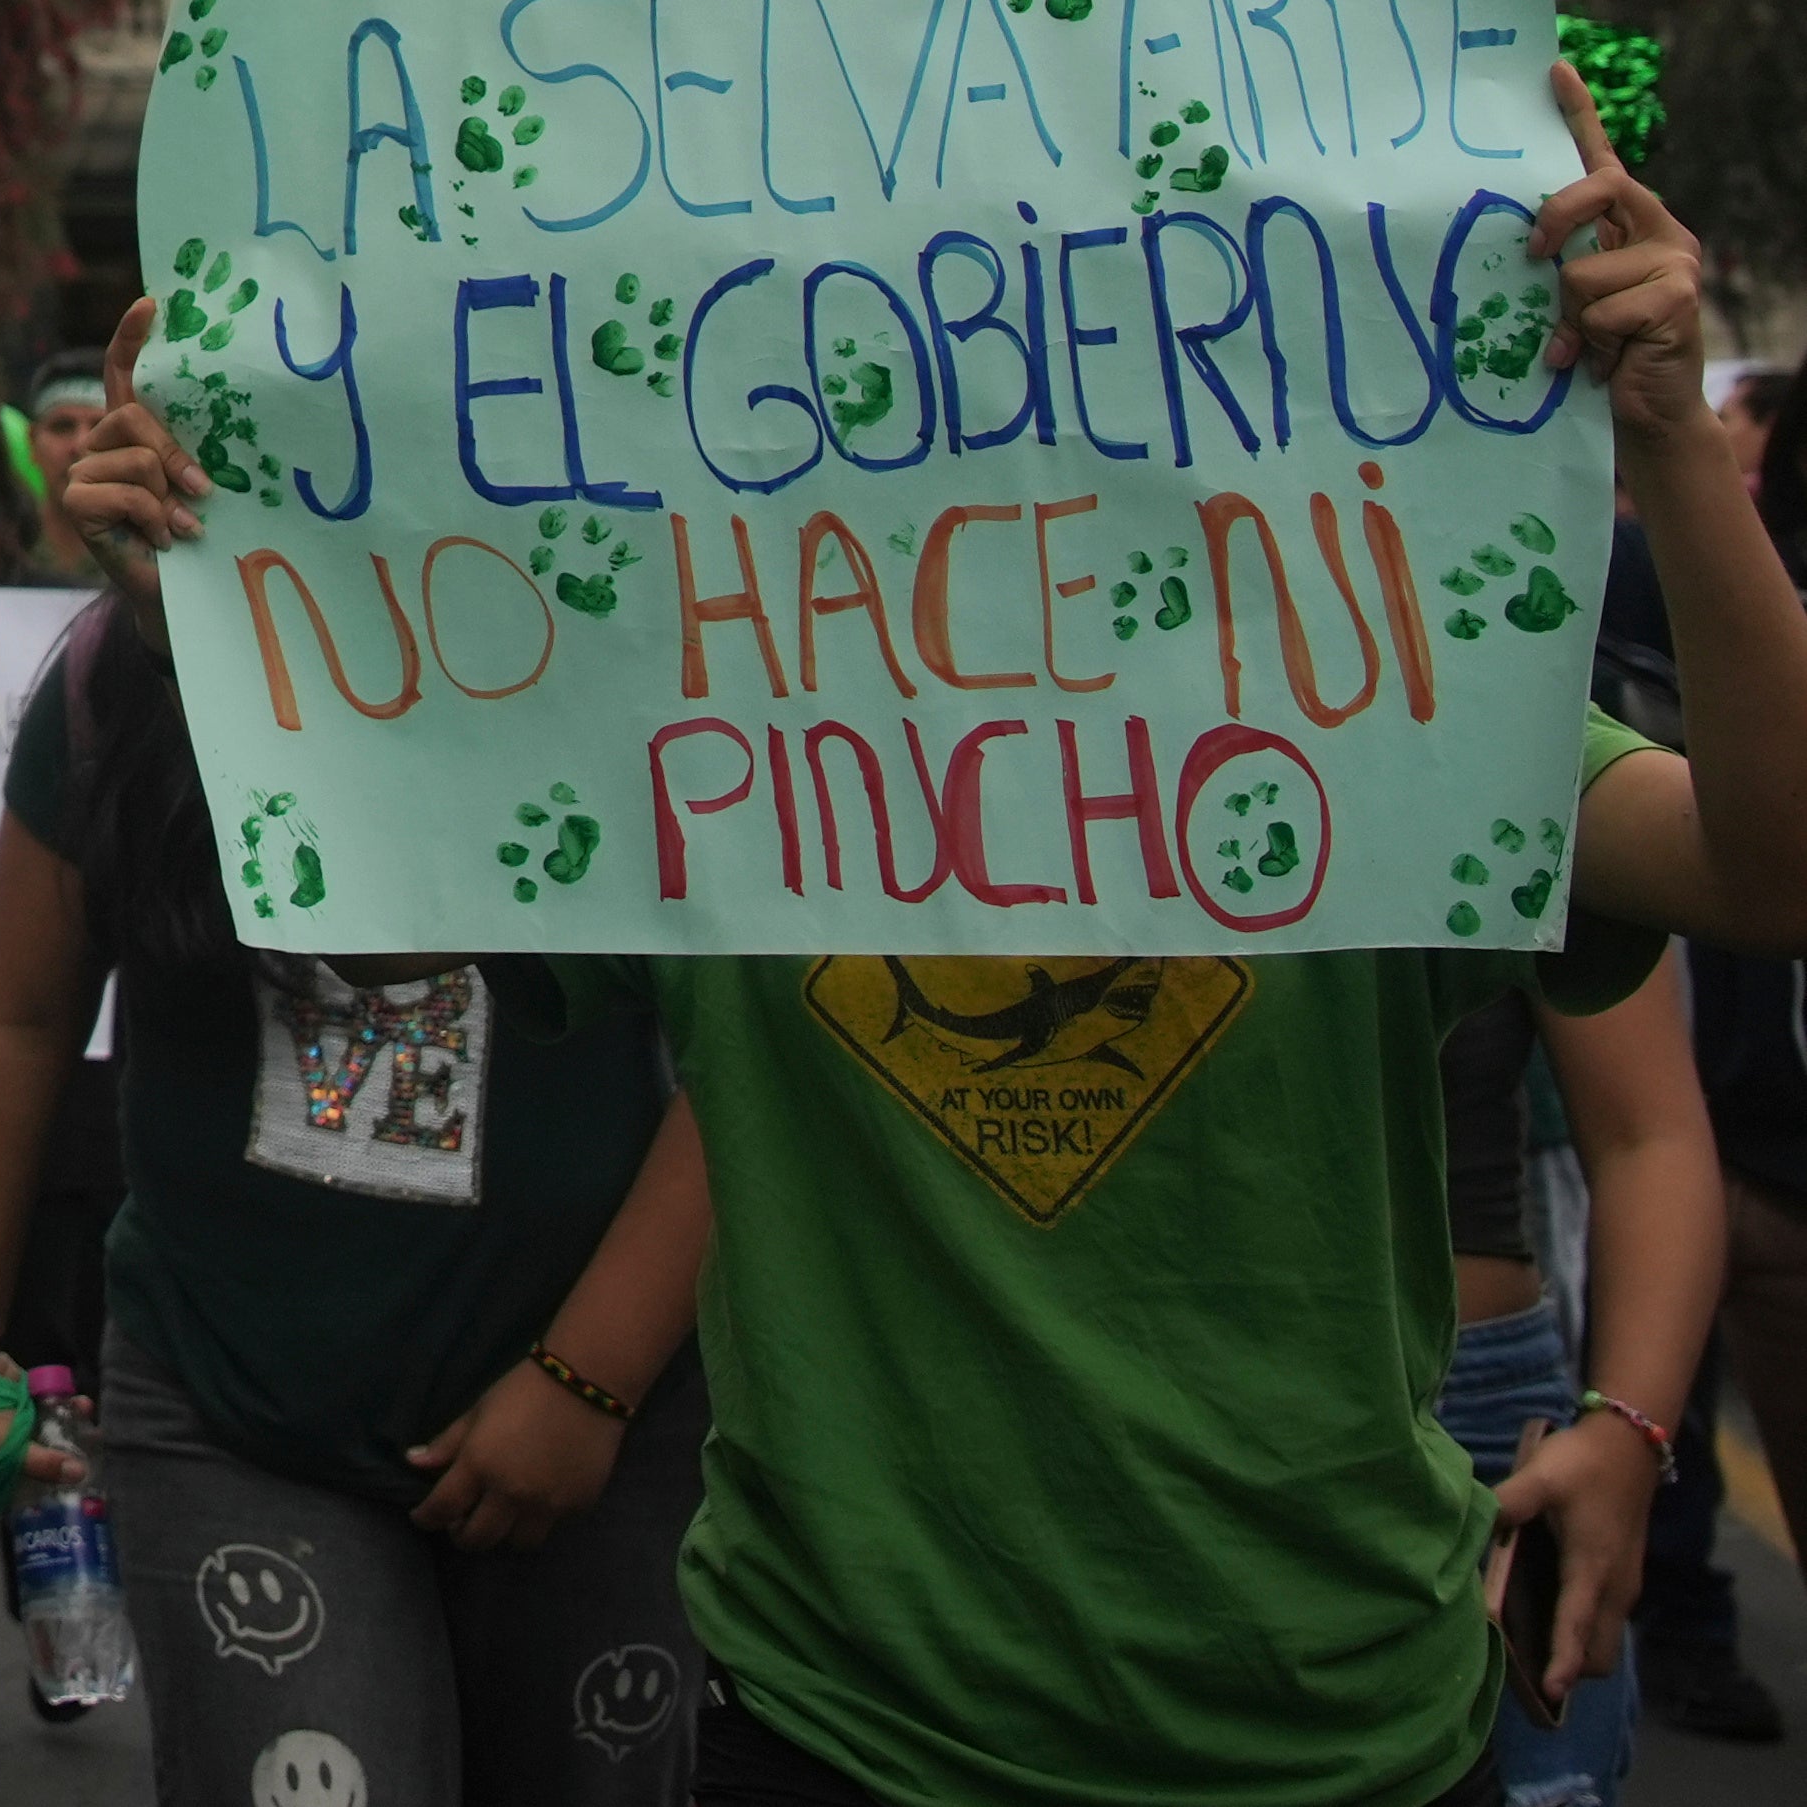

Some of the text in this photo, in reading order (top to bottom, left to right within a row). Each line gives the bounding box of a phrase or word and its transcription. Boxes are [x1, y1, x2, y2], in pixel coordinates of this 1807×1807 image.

[233, 18, 442, 262] LA
[273, 280, 374, 522] Y
[455, 272, 665, 510] EL
[235, 536, 554, 733] NO
[670, 493, 1117, 699] HACE
[648, 714, 1332, 933] PINCHO
[940, 1088, 1125, 1111] AT YOUR OWN
[976, 1118, 1094, 1156] RISK!
